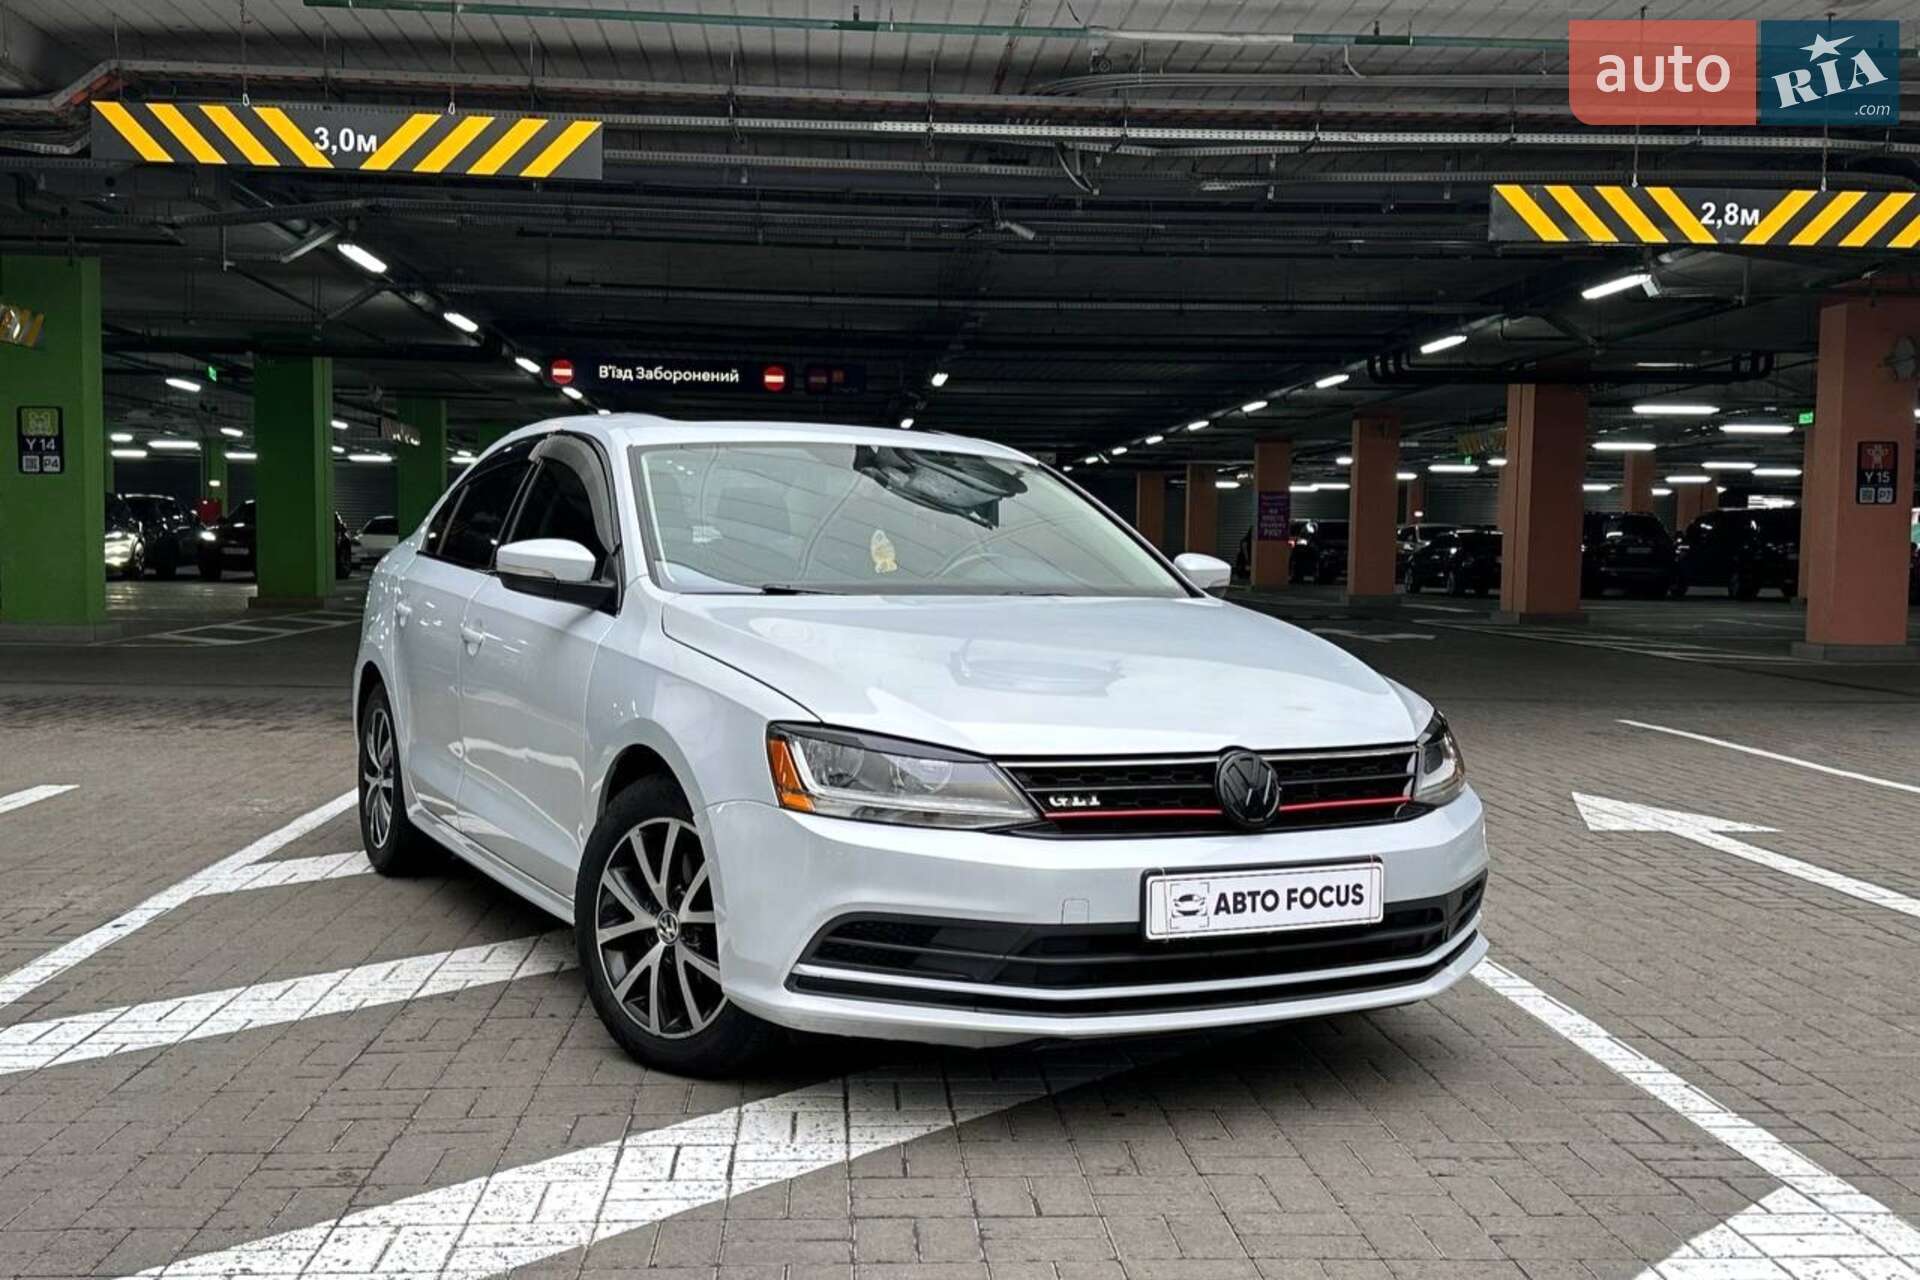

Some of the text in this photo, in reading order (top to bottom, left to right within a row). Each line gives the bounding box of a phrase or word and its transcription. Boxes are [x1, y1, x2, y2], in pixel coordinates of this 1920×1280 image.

[314, 127, 377, 155] 3,0м
[1701, 202, 1760, 229] 2,8м
[635, 366, 739, 384] Заборонений
[39, 438, 55, 450] 14
[1876, 471, 1890, 483] 15
[1286, 882, 1364, 911] FOCUS
